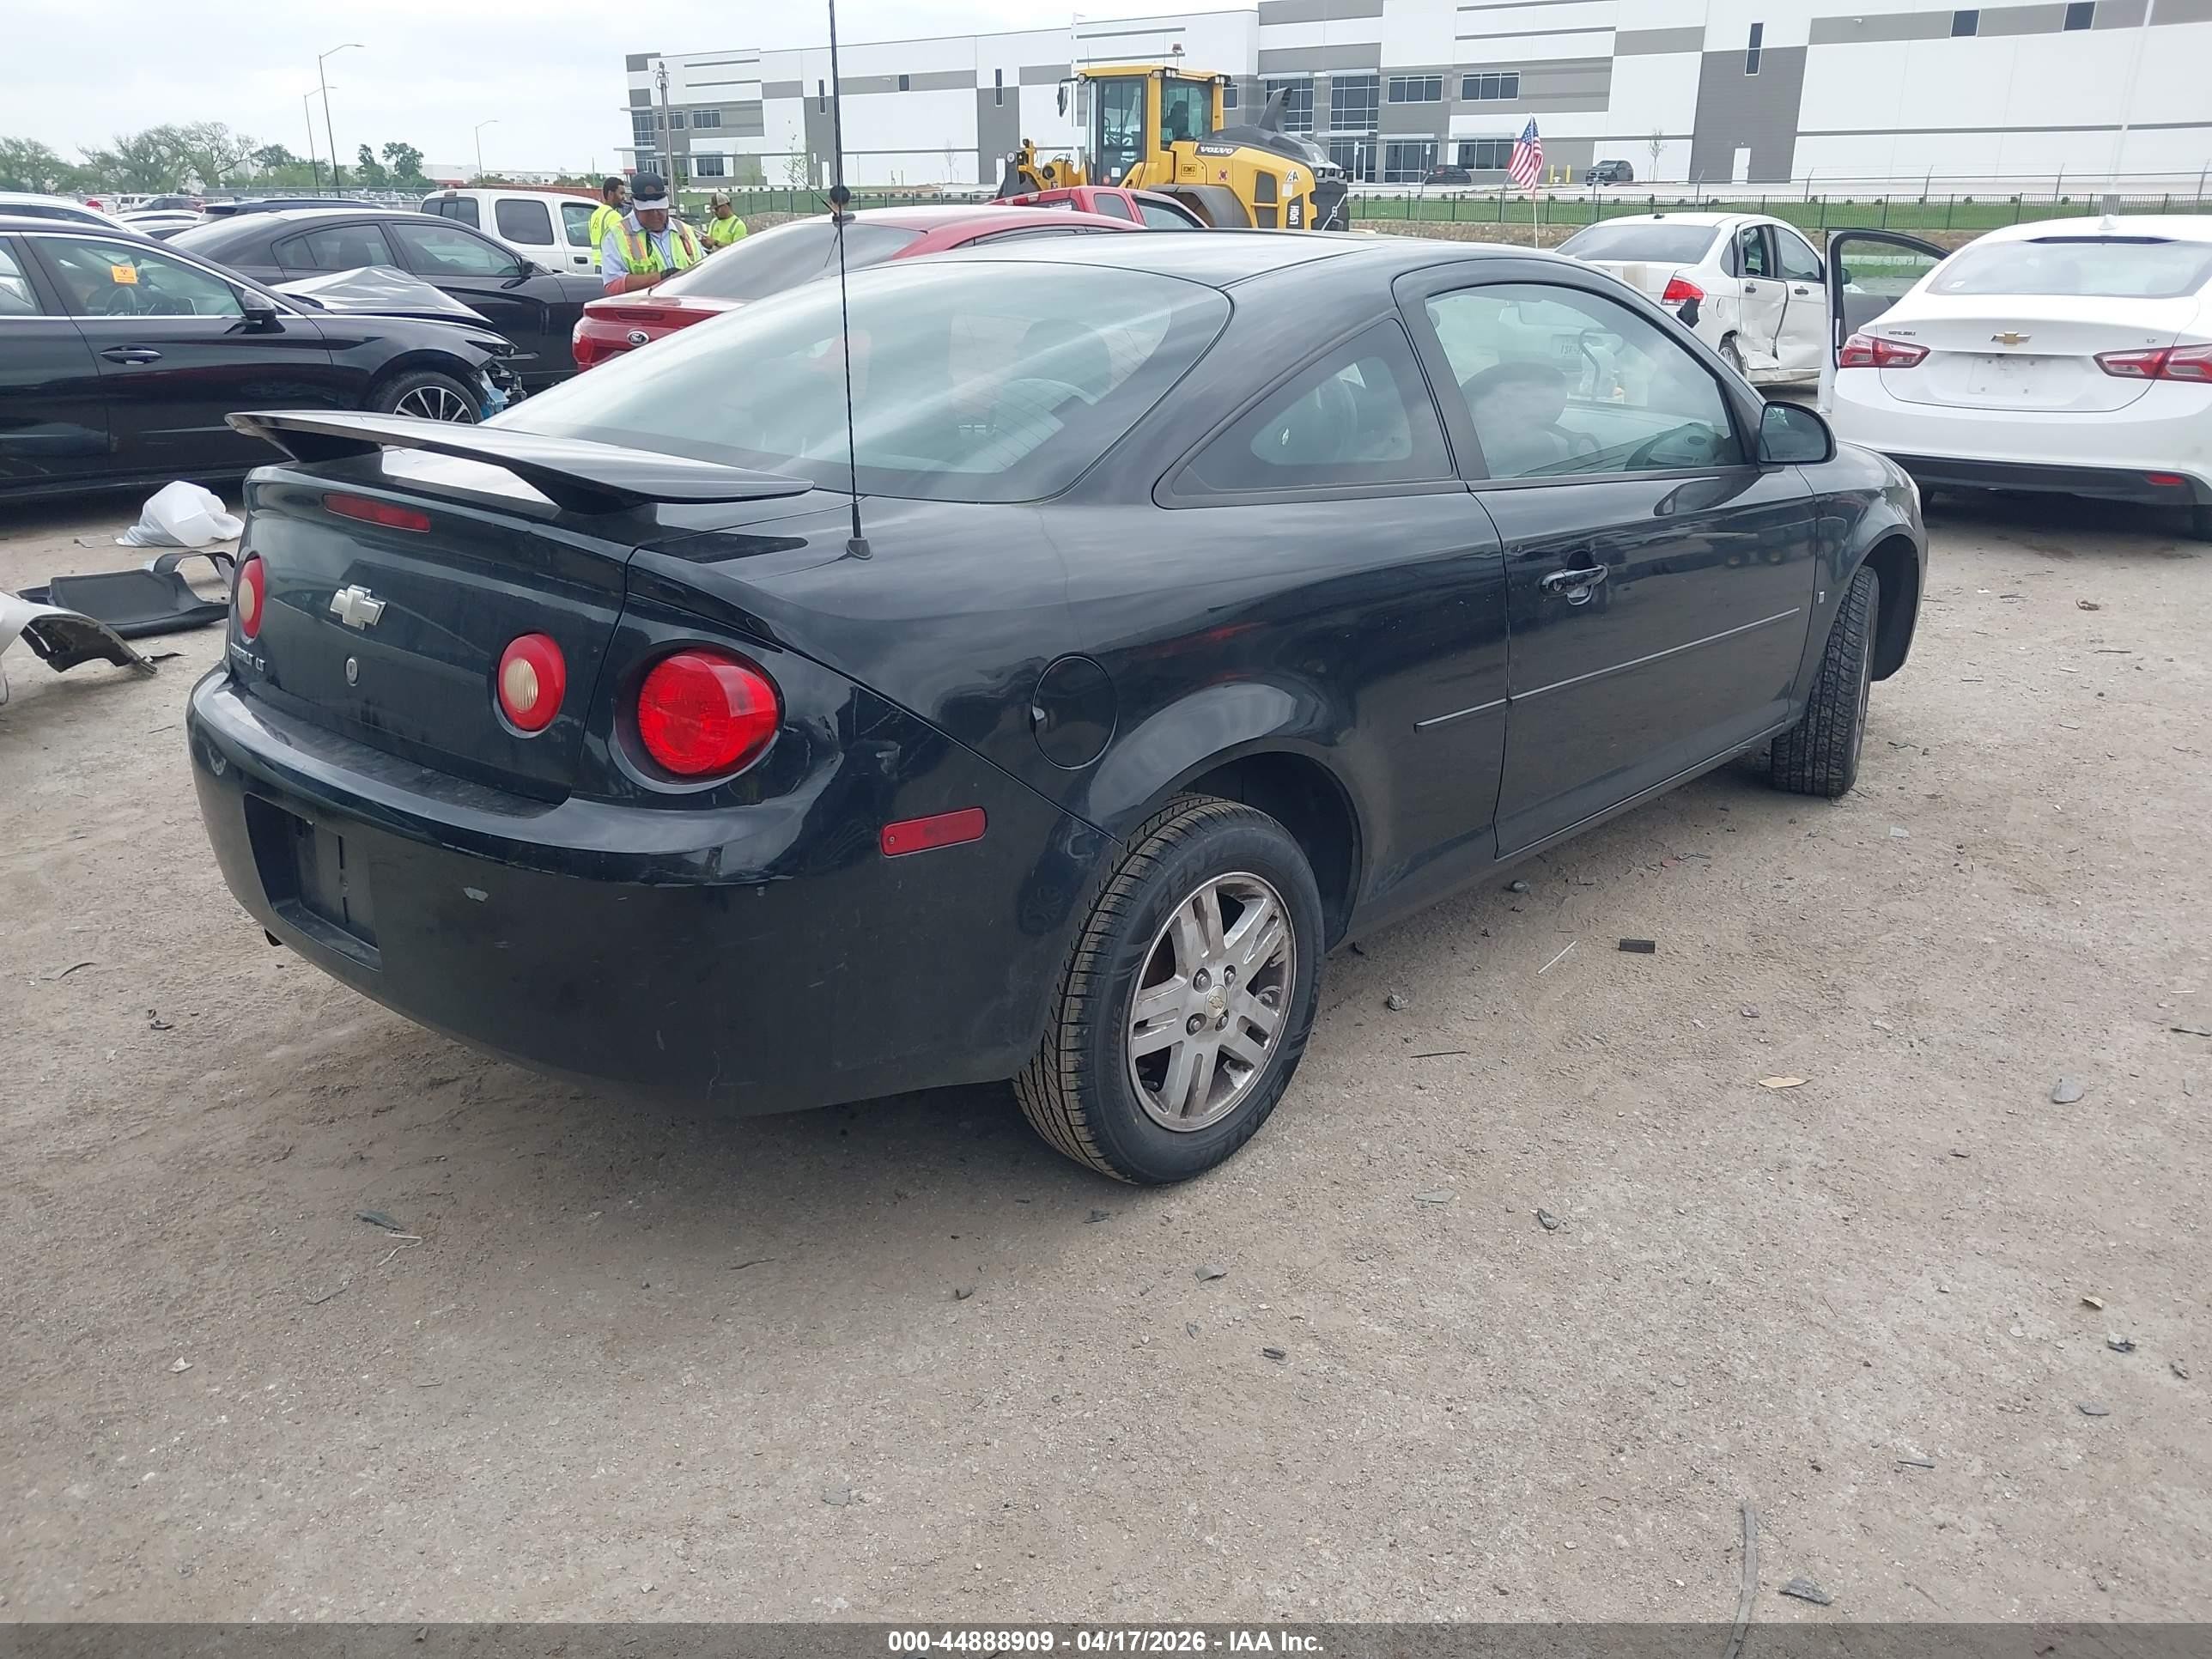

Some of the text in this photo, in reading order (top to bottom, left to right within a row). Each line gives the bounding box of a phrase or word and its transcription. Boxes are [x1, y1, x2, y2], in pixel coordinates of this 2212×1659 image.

[1200, 145, 1234, 155] VOLVO
[1289, 204, 1300, 226] L90H
[255, 657, 265, 672] LT
